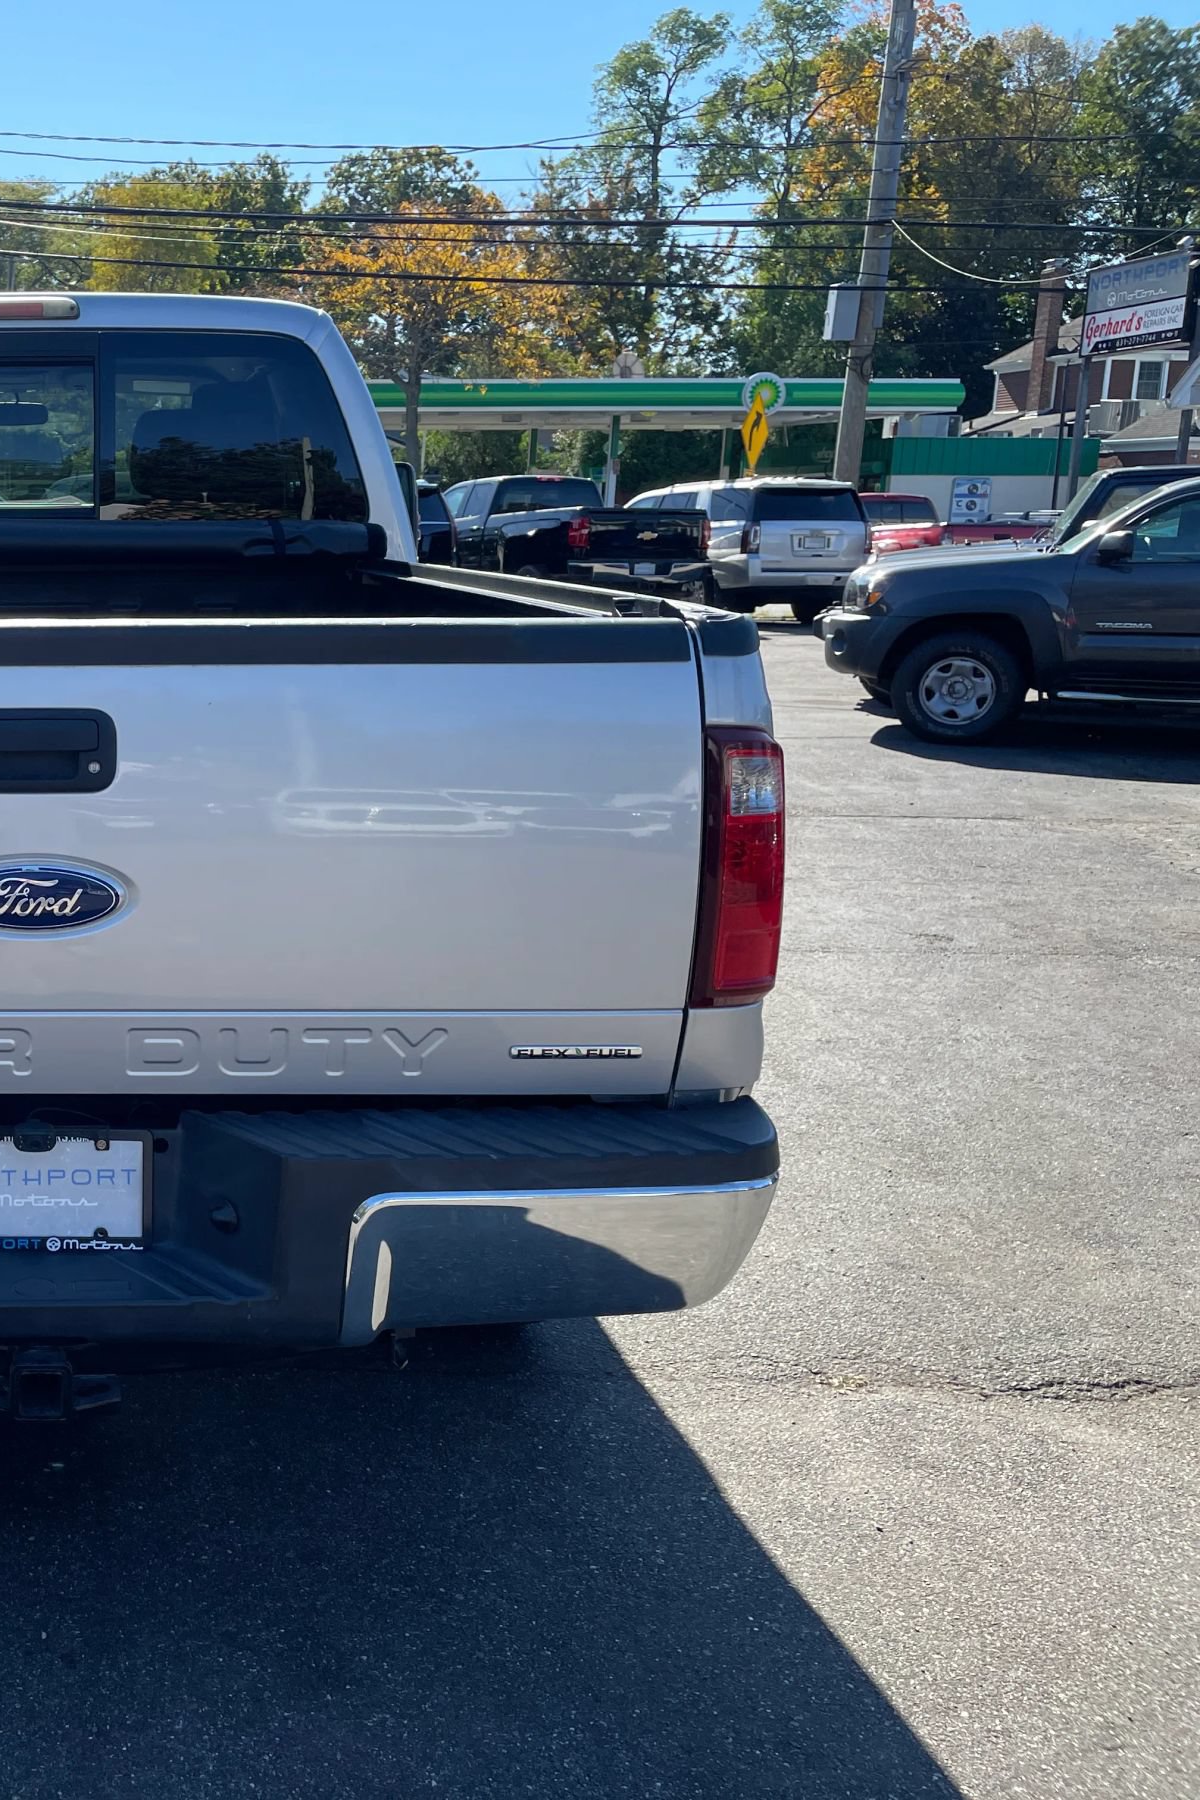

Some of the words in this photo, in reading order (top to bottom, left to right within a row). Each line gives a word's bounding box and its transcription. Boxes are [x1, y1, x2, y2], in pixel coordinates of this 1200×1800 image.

[1090, 256, 1190, 291] NORTHPORT
[1117, 287, 1168, 303] Motors
[1144, 306, 1170, 319] FOREIGN
[1171, 303, 1183, 315] CAR
[1086, 310, 1143, 347] Gerhard's
[1143, 317, 1166, 329] REPAIRS
[126, 1027, 449, 1077] DUTY
[517, 1048, 570, 1057] FLEX
[585, 1048, 636, 1058] FUEL
[63, 1239, 144, 1250] Motors
